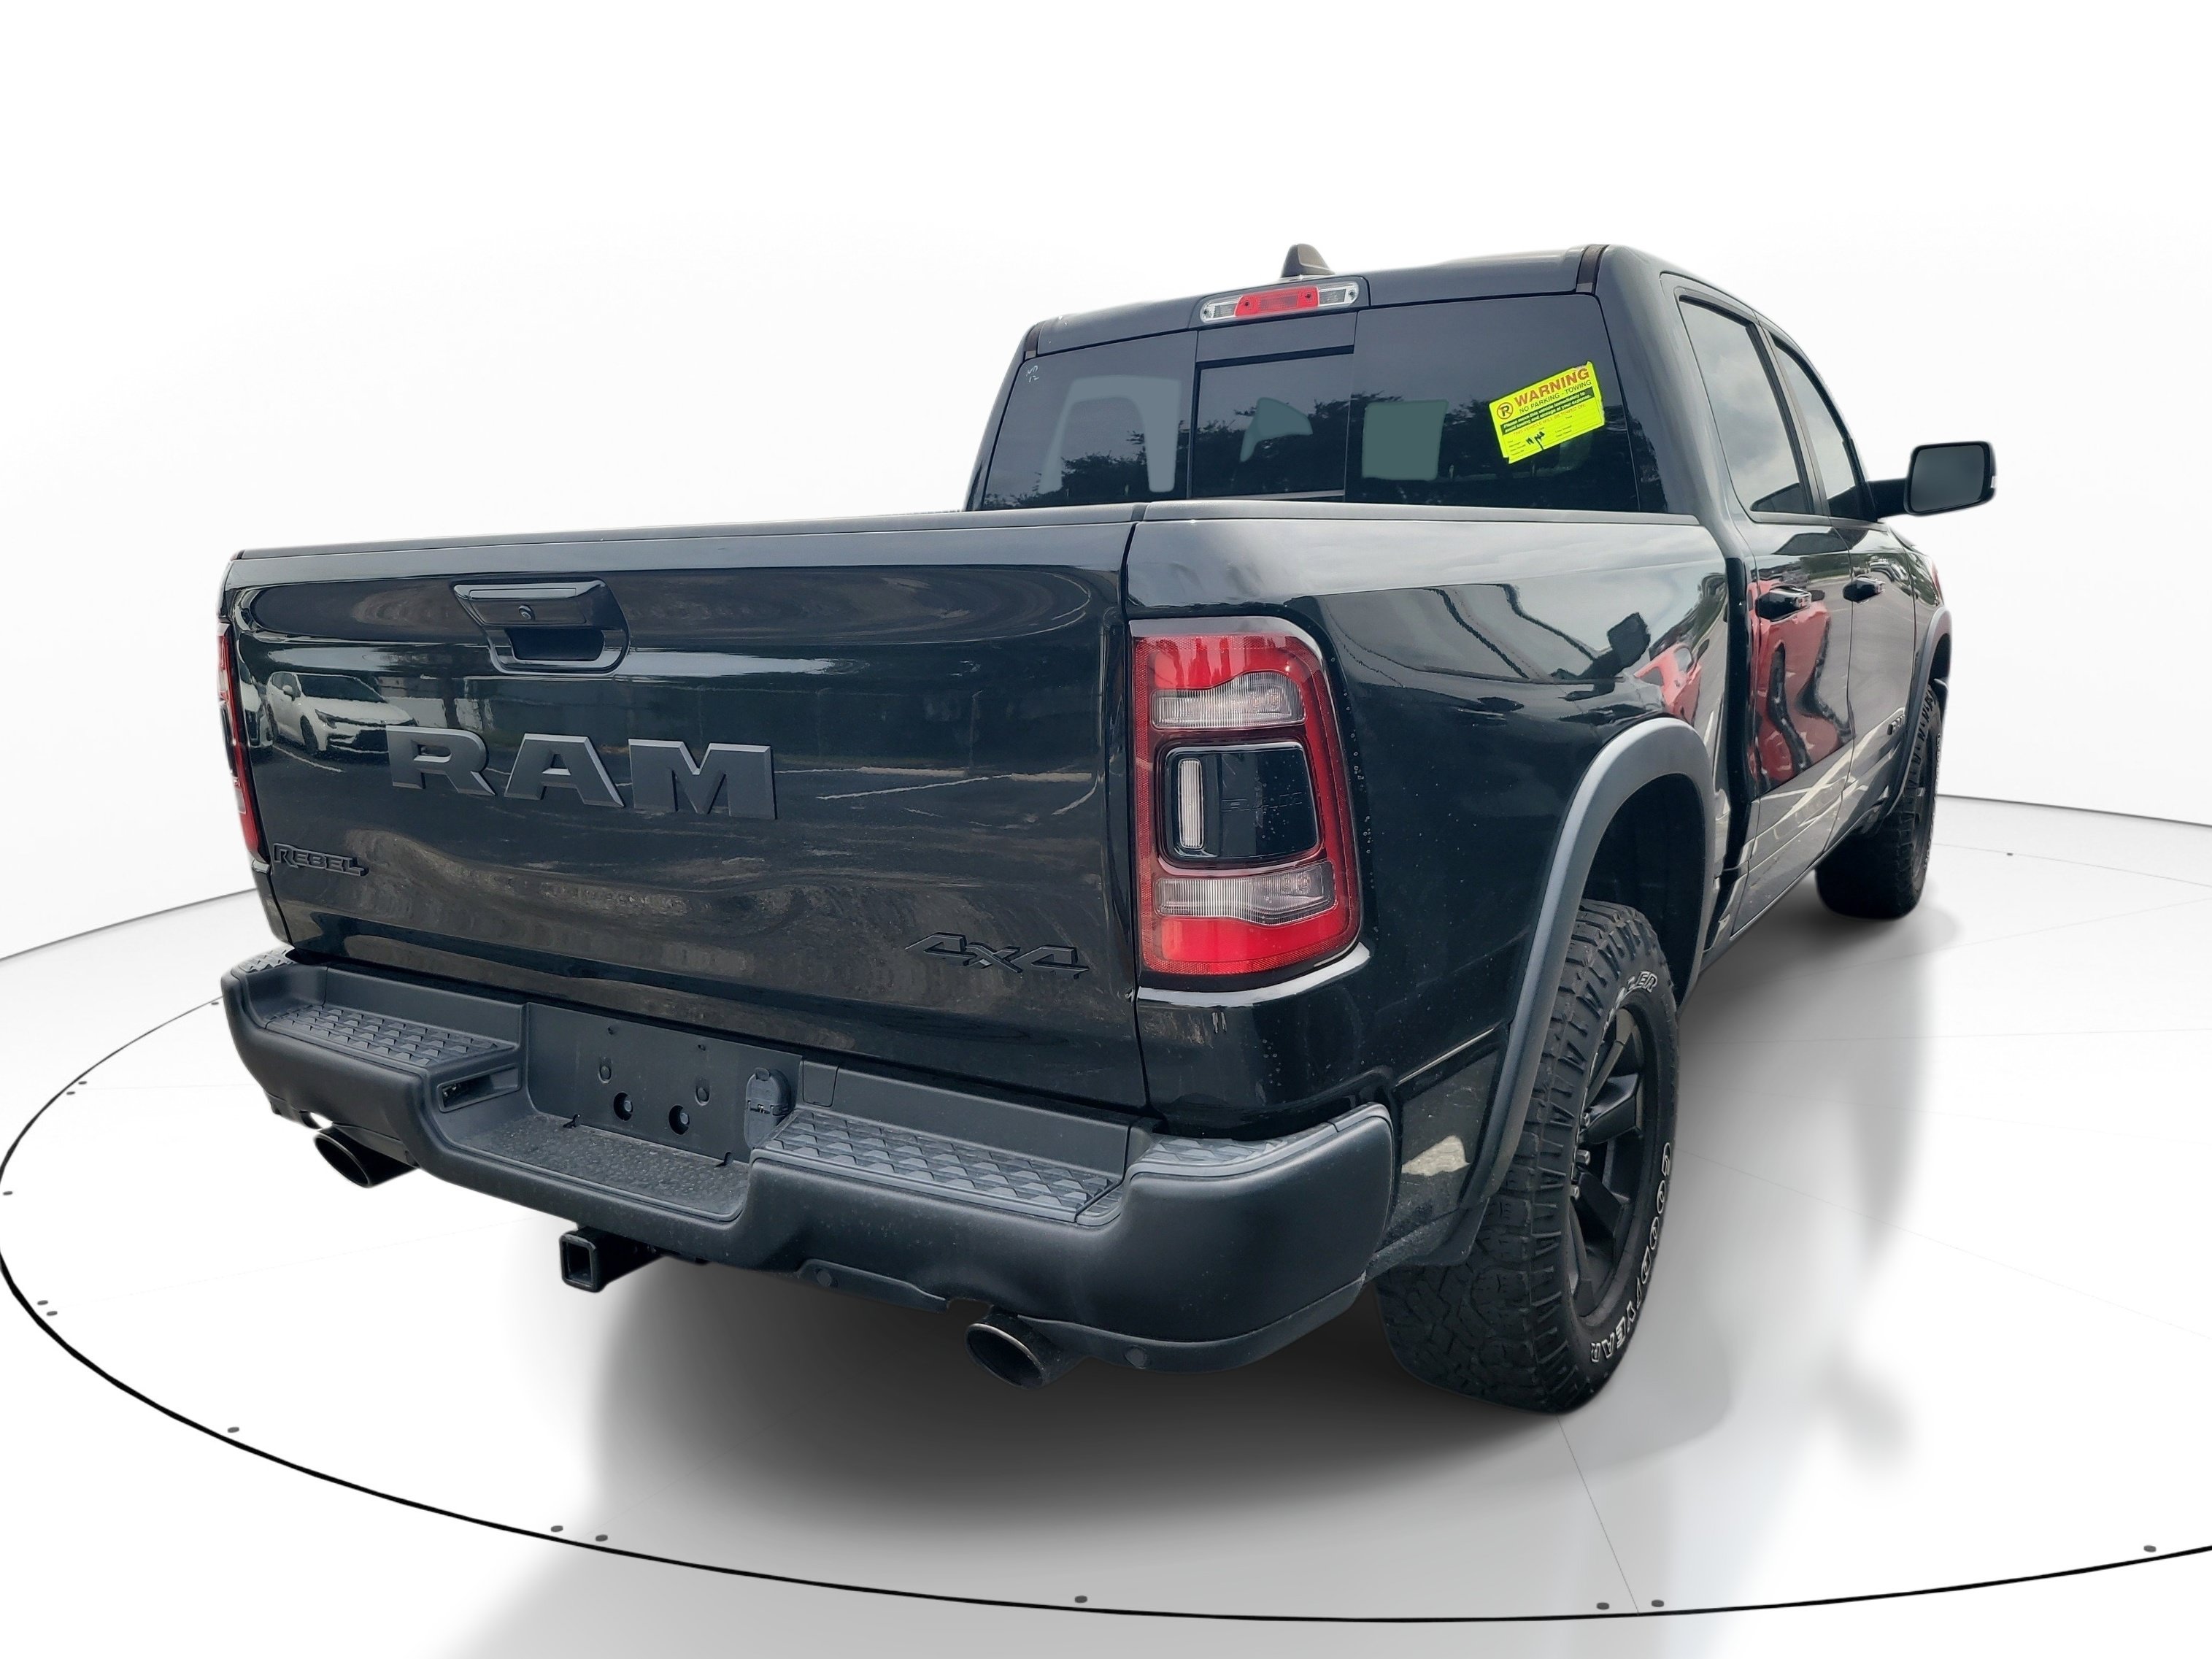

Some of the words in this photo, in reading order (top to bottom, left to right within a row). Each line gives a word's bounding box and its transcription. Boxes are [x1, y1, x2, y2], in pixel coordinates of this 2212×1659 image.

[1514, 368, 1589, 407] WARNING
[1530, 393, 1560, 408] PARKING
[1565, 380, 1592, 394] TOWING
[1503, 420, 1518, 428] Please
[1538, 404, 1554, 413] vehicle
[1554, 394, 1579, 407] immediately
[1504, 425, 1517, 433] avoid
[1516, 419, 1531, 428] towing
[1539, 408, 1557, 418] storage
[386, 725, 778, 820] RAM
[274, 843, 367, 877] REBEL
[1591, 1142, 1671, 1363] GOODYEAR
